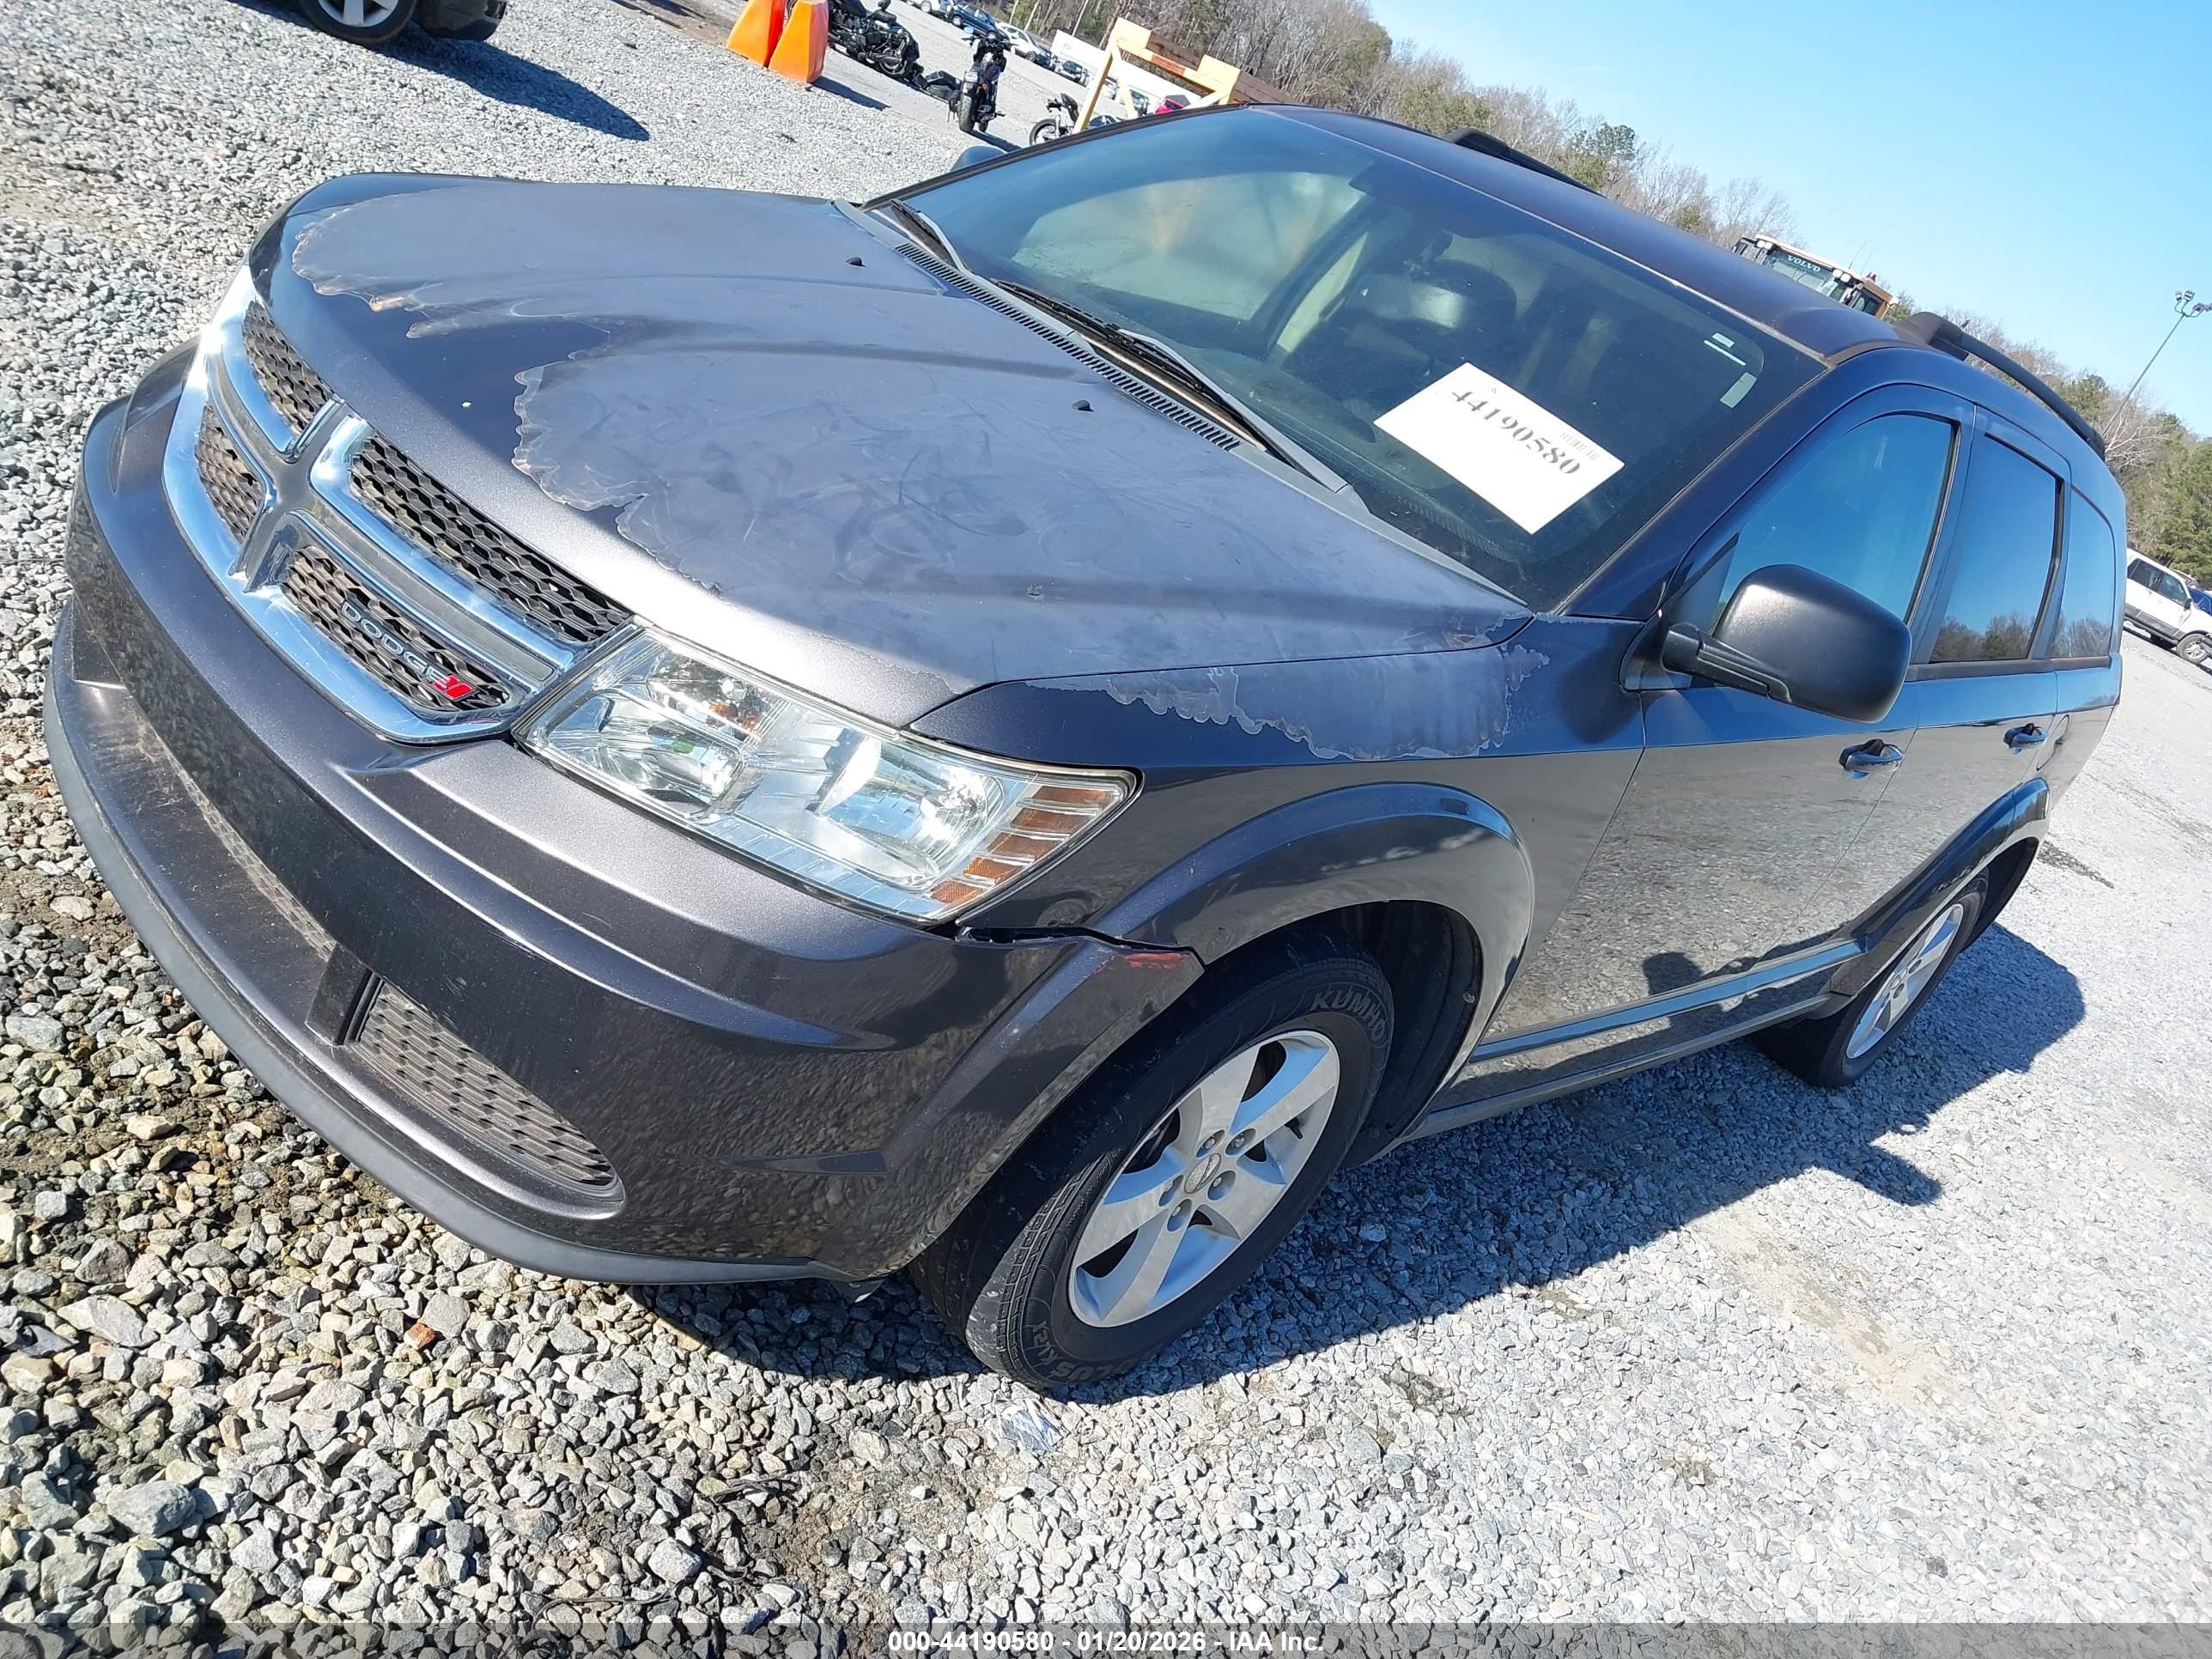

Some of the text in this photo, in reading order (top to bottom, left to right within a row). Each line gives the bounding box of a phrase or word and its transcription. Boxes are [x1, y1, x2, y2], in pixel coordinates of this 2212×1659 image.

[1787, 255, 1820, 272] VOLVO
[1451, 391, 1580, 474] 44190580
[342, 603, 451, 689] DODGE
[1309, 988, 1386, 1042] KUMHO
